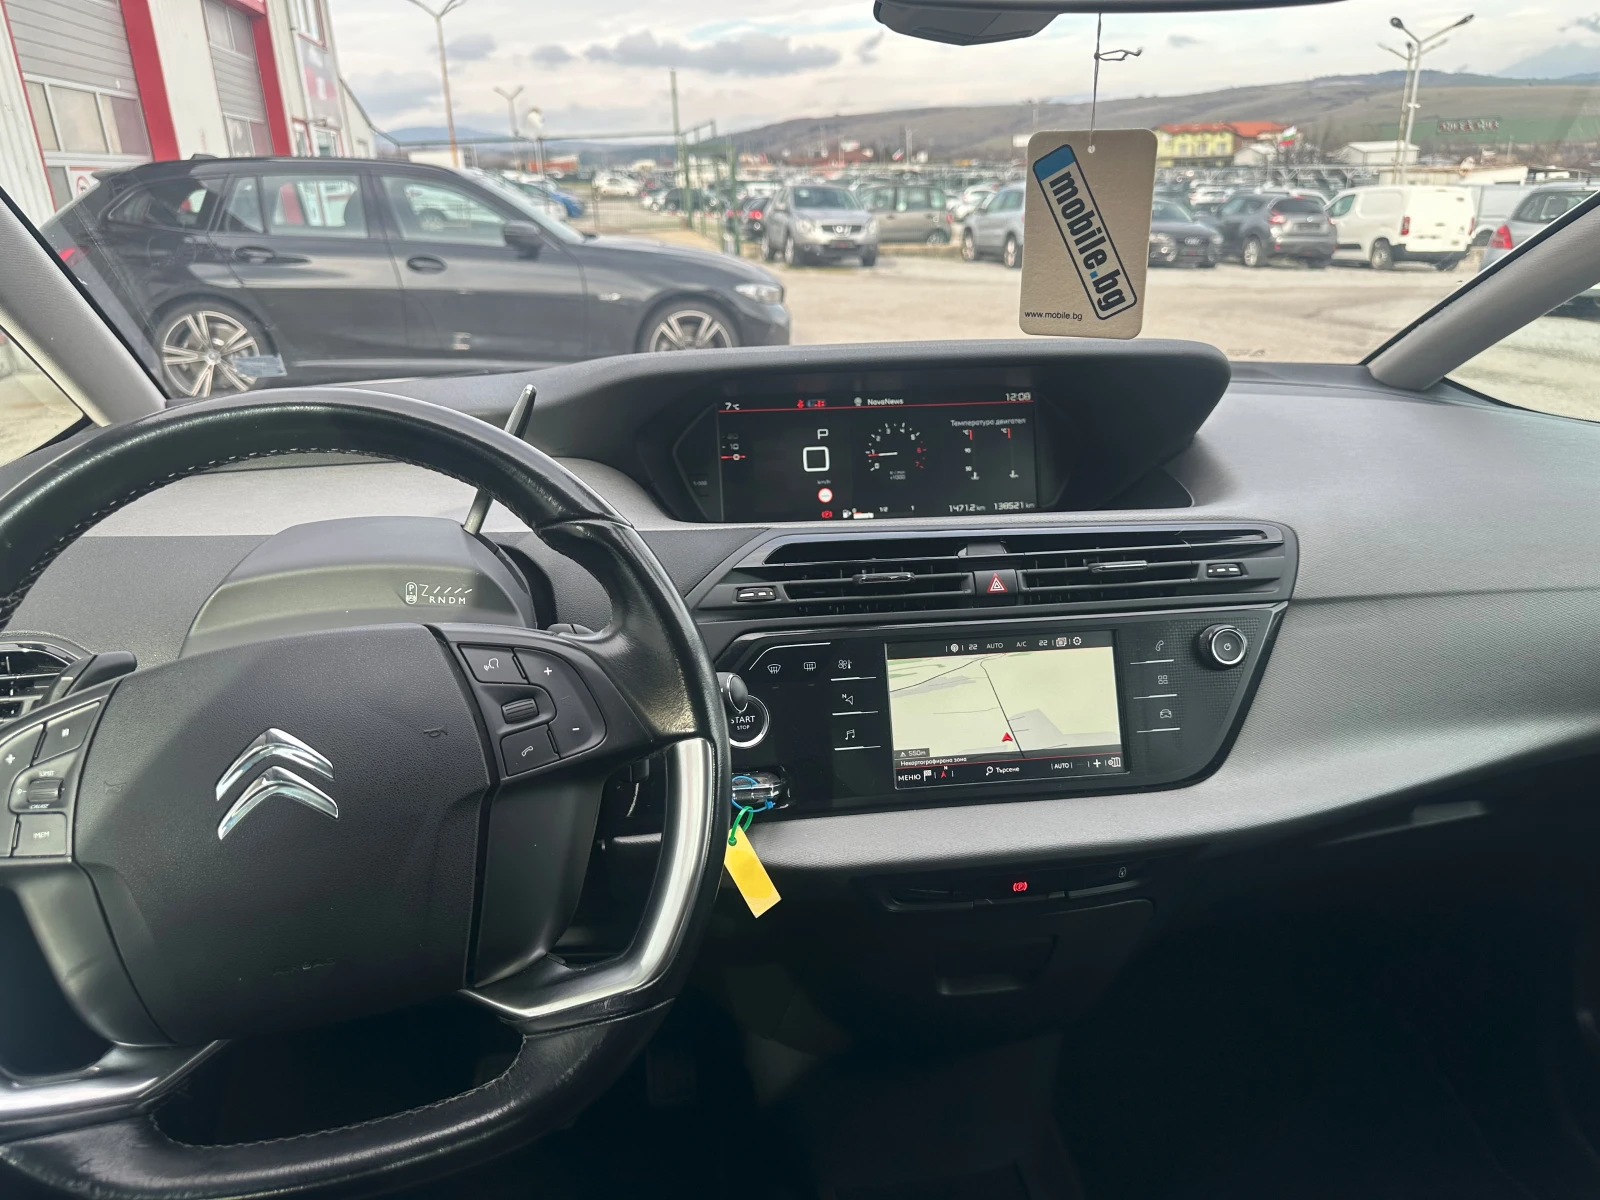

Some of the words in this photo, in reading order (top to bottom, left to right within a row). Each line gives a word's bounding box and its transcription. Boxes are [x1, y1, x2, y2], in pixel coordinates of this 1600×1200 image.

[1049, 171, 1126, 312] mobile.bg
[1024, 310, 1083, 321] www.mobile.bg
[817, 428, 829, 440] P
[995, 766, 1020, 774] Търсене
[898, 773, 921, 782] МЕНЮ
